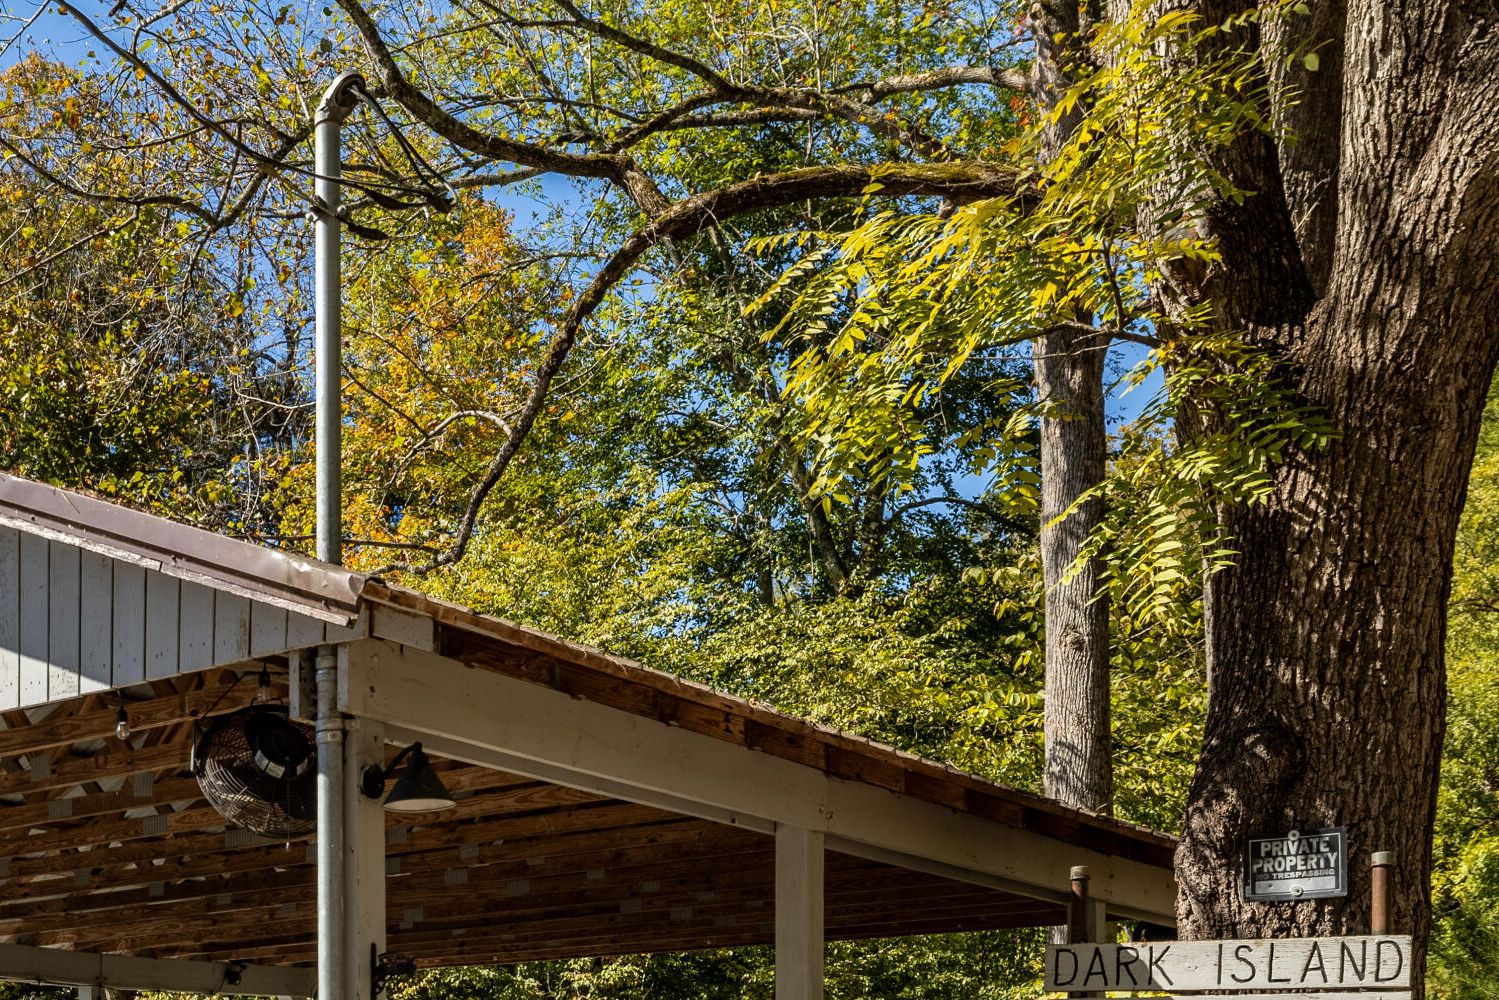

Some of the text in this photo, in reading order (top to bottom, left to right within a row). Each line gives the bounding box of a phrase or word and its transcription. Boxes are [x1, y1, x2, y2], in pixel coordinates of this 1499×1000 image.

[1260, 837, 1330, 857] PRIVATE
[1252, 852, 1338, 873] PROPERTY
[1272, 868, 1335, 879] TRESPASSING
[1053, 940, 1403, 987] DARK ISLAND
